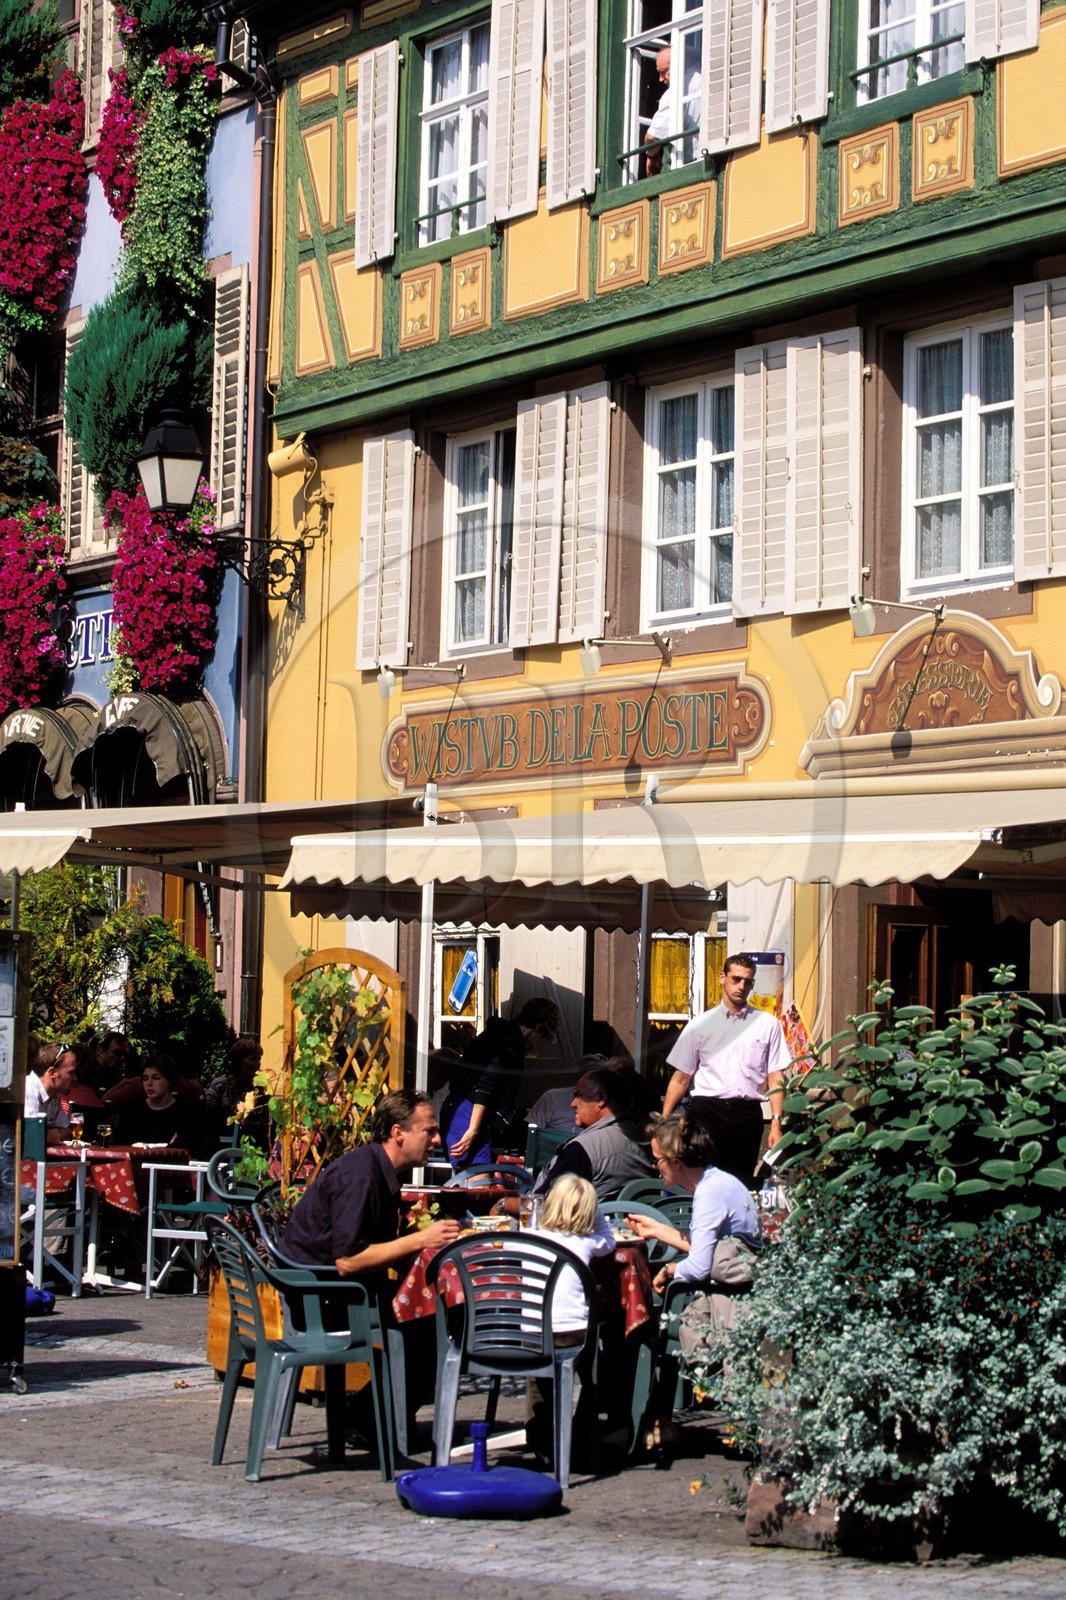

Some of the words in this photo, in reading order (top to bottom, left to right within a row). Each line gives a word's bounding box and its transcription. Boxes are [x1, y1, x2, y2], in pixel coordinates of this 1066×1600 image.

[525, 704, 566, 768] DE
[570, 701, 611, 763] LA
[617, 690, 729, 760] POSTE
[888, 659, 993, 728] BRASSERIE
